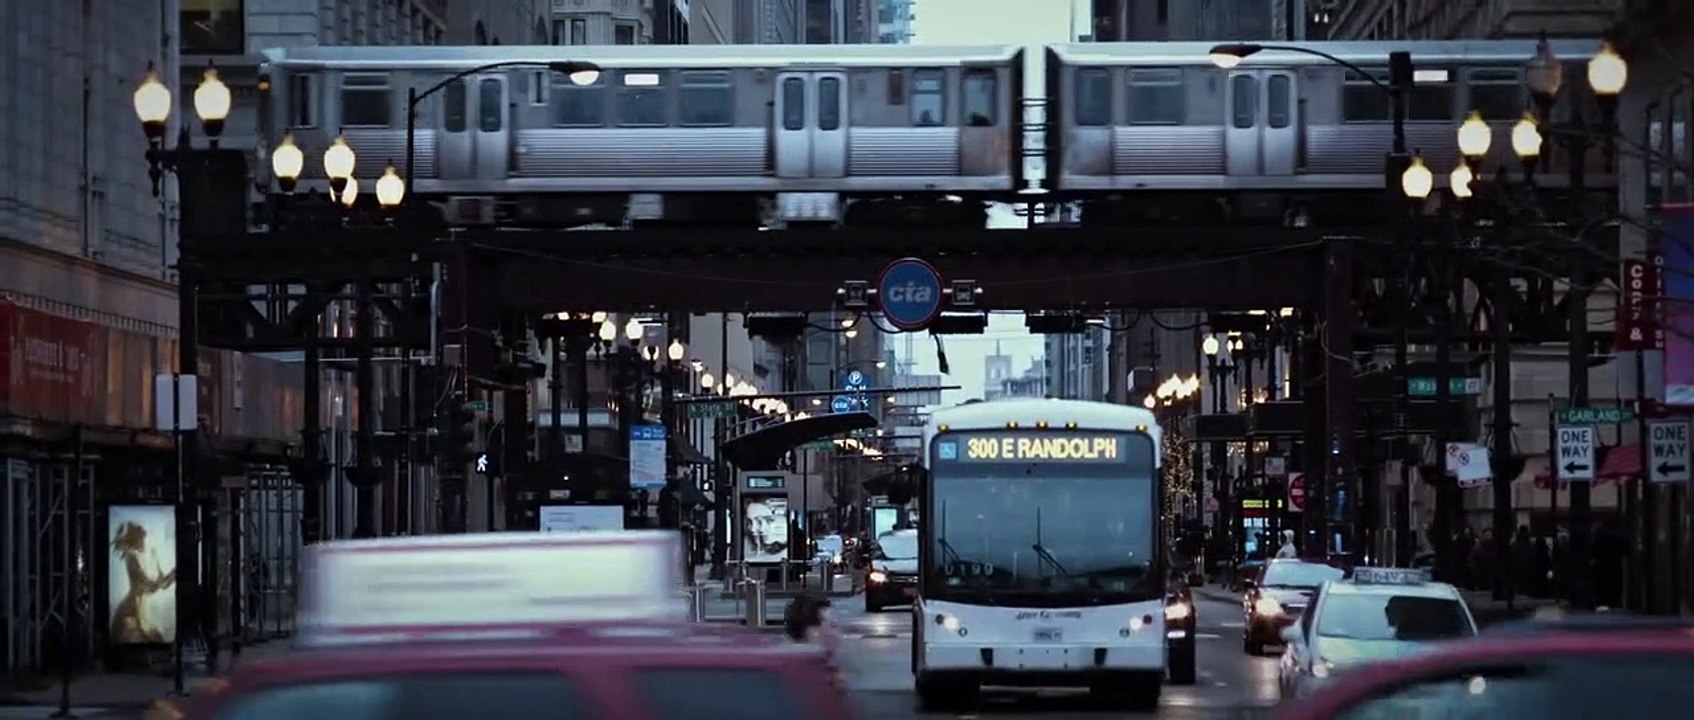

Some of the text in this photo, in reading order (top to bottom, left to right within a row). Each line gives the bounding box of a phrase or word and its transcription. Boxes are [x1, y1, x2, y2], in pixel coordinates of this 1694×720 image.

[1630, 327, 1642, 341] &
[1568, 409, 1621, 423] GARLAND
[1560, 430, 1590, 444] ONE
[1653, 425, 1686, 441] ONE
[967, 438, 1117, 459] 300 E RANDOLPH
[1561, 445, 1590, 458] WAY
[1654, 443, 1686, 458] WAY
